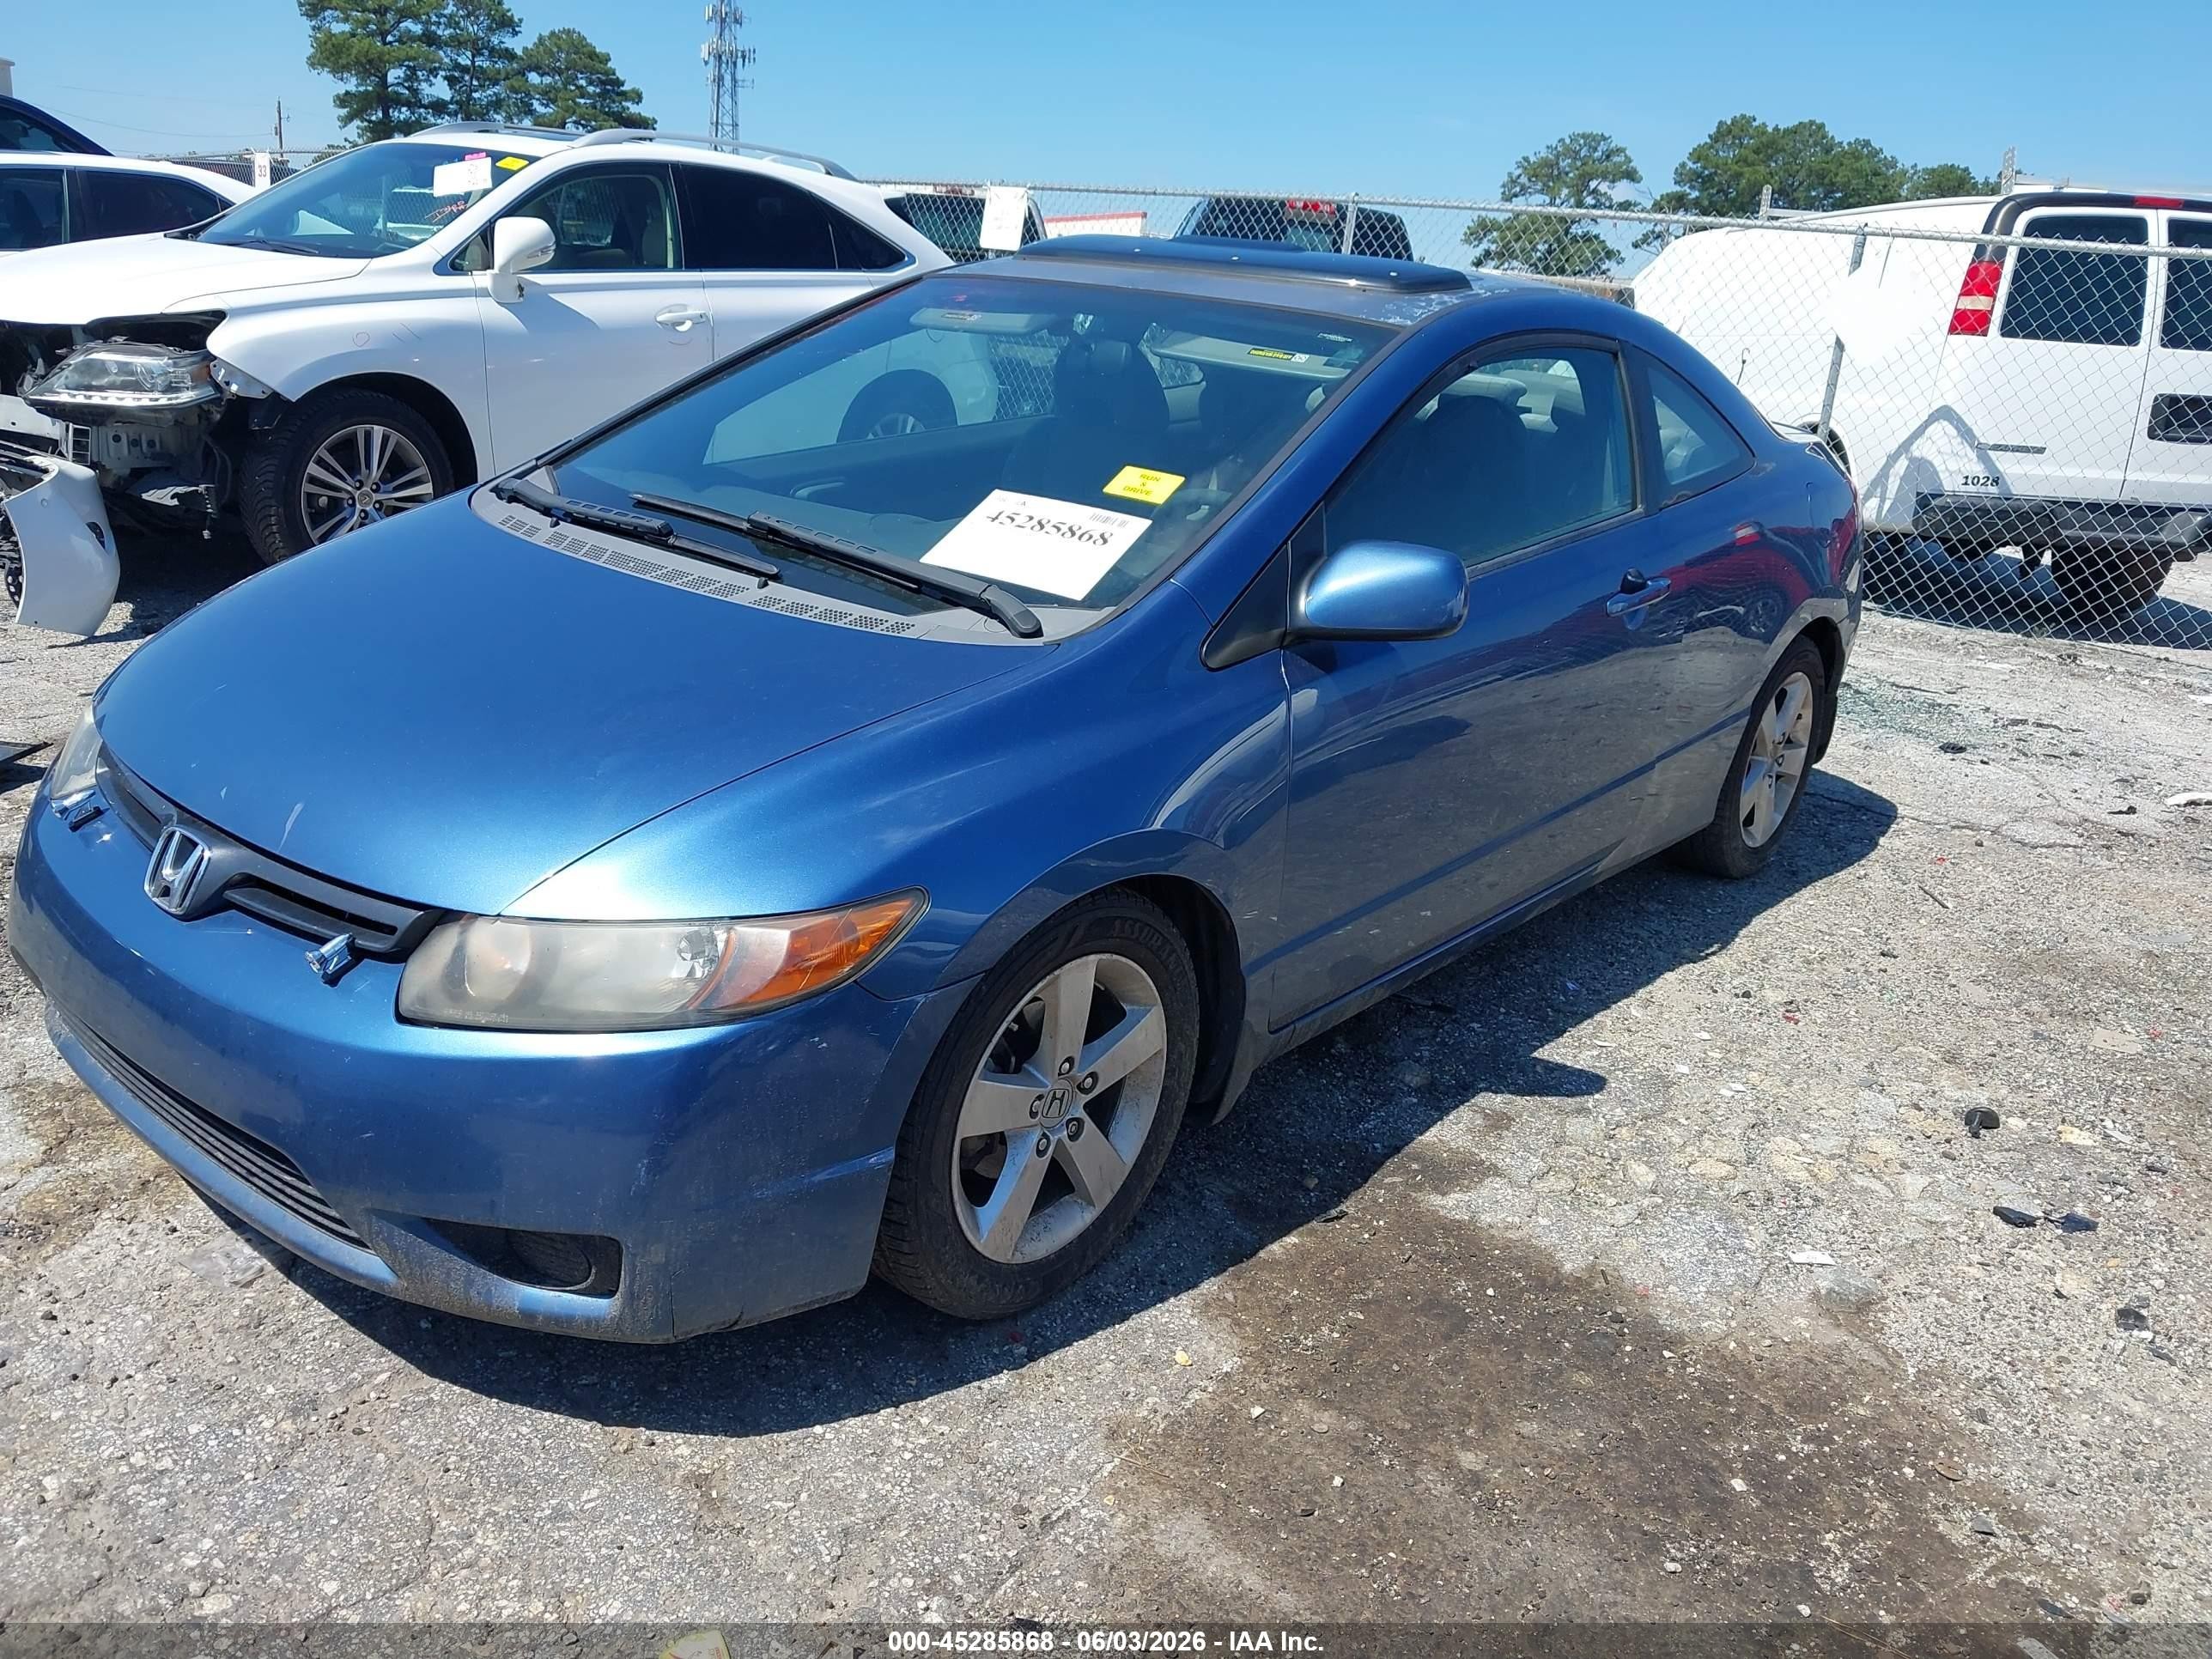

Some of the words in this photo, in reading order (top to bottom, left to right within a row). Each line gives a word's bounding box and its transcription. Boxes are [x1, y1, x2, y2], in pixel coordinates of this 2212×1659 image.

[258, 164, 267, 178] 33
[1139, 473, 1161, 482] RUN
[1961, 475, 2000, 487] 1028
[1123, 486, 1153, 496] DRIVE
[987, 510, 1114, 546] 45285868
